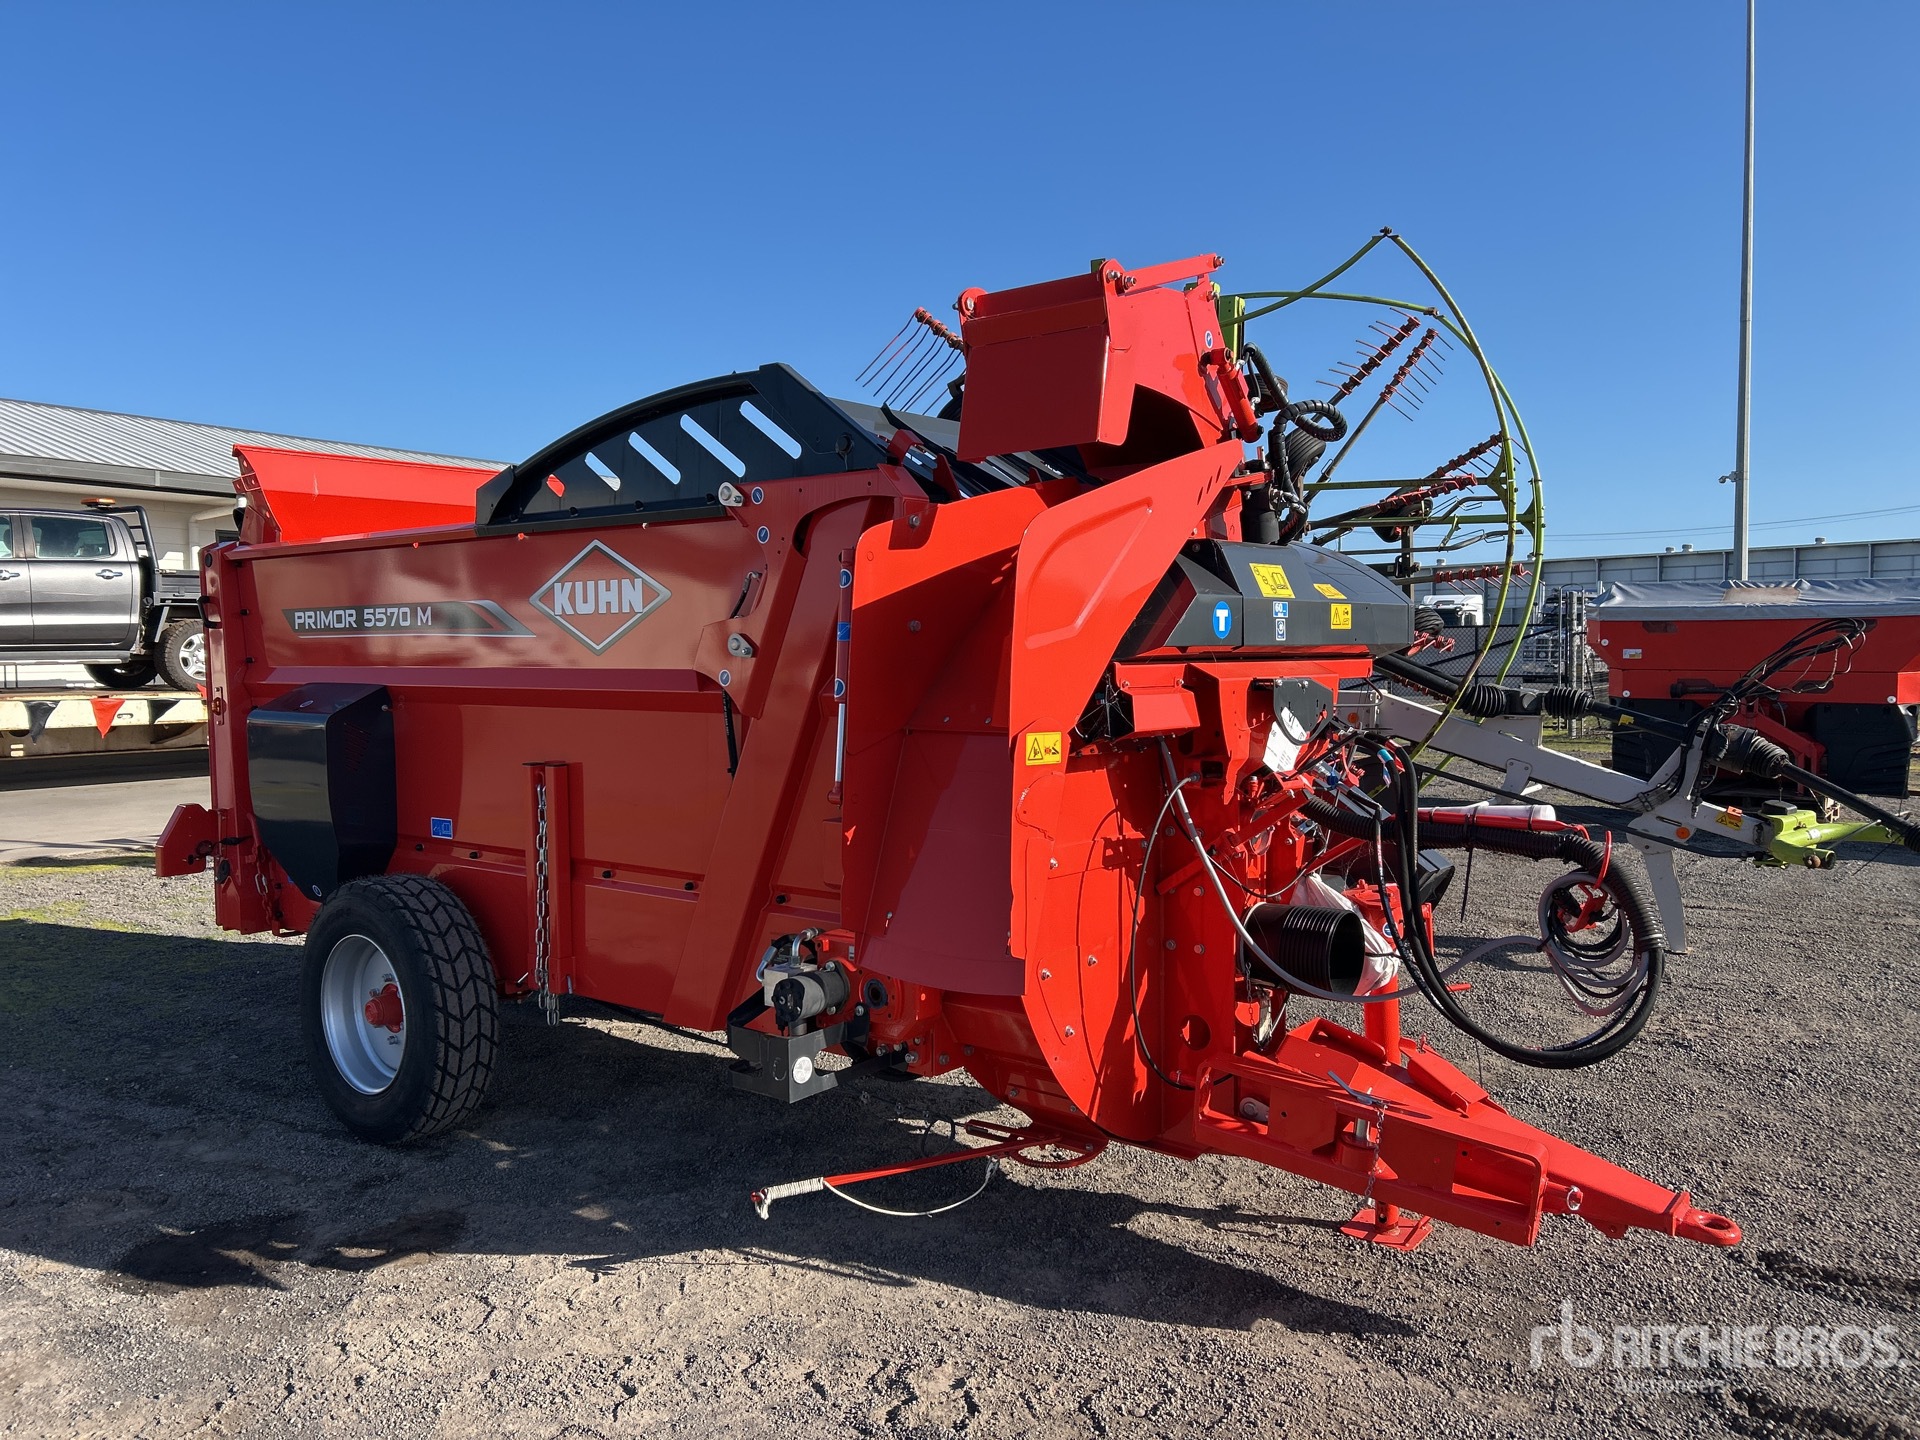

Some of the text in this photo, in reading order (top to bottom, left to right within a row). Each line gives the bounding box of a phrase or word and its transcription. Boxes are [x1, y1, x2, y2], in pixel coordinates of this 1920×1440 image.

[554, 578, 643, 615] KUHN
[294, 607, 432, 630] PRIMOR 5570 M
[1216, 609, 1229, 632] T
